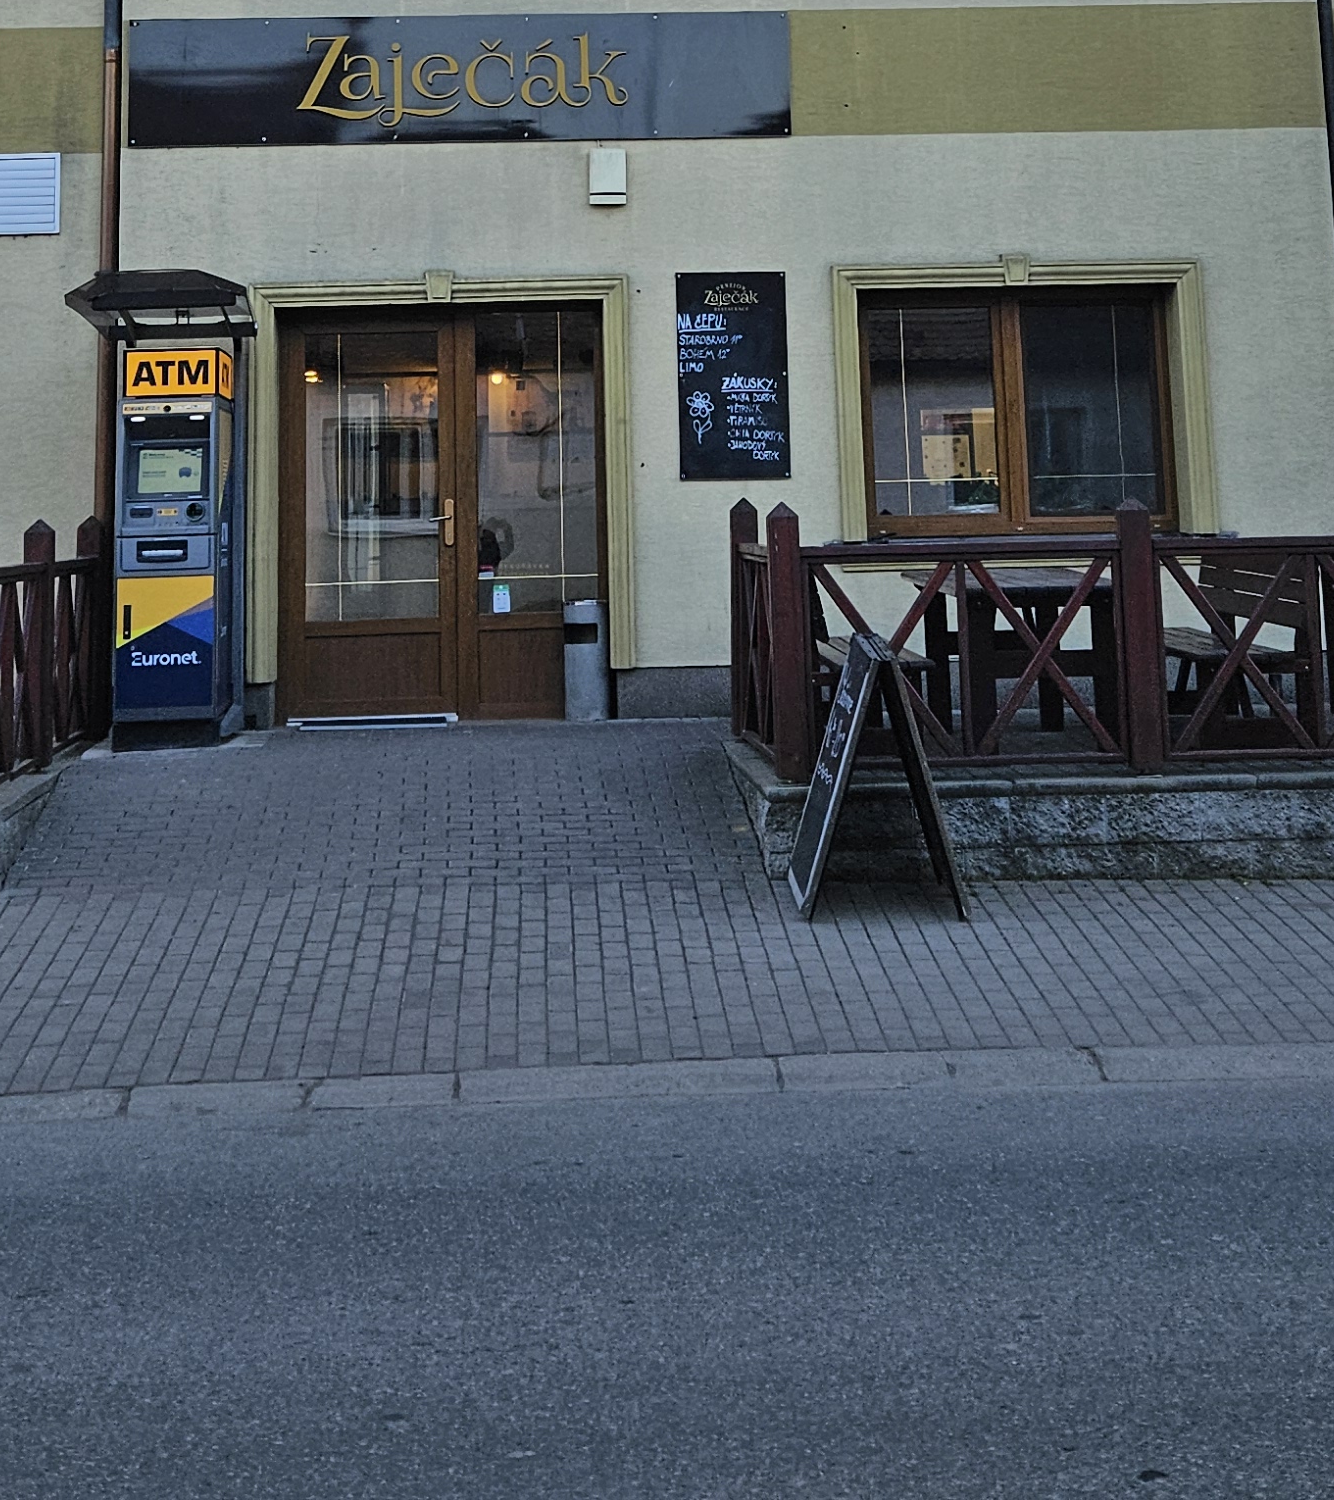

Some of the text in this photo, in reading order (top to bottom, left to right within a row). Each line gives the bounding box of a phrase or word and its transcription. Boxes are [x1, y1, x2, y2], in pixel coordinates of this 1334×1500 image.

[295, 31, 629, 128] Zaječák
[703, 289, 760, 307] Zaječák
[677, 313, 692, 330] NA
[131, 359, 210, 388] ATM
[679, 361, 704, 373] LIMO
[131, 650, 198, 667] Euronet
